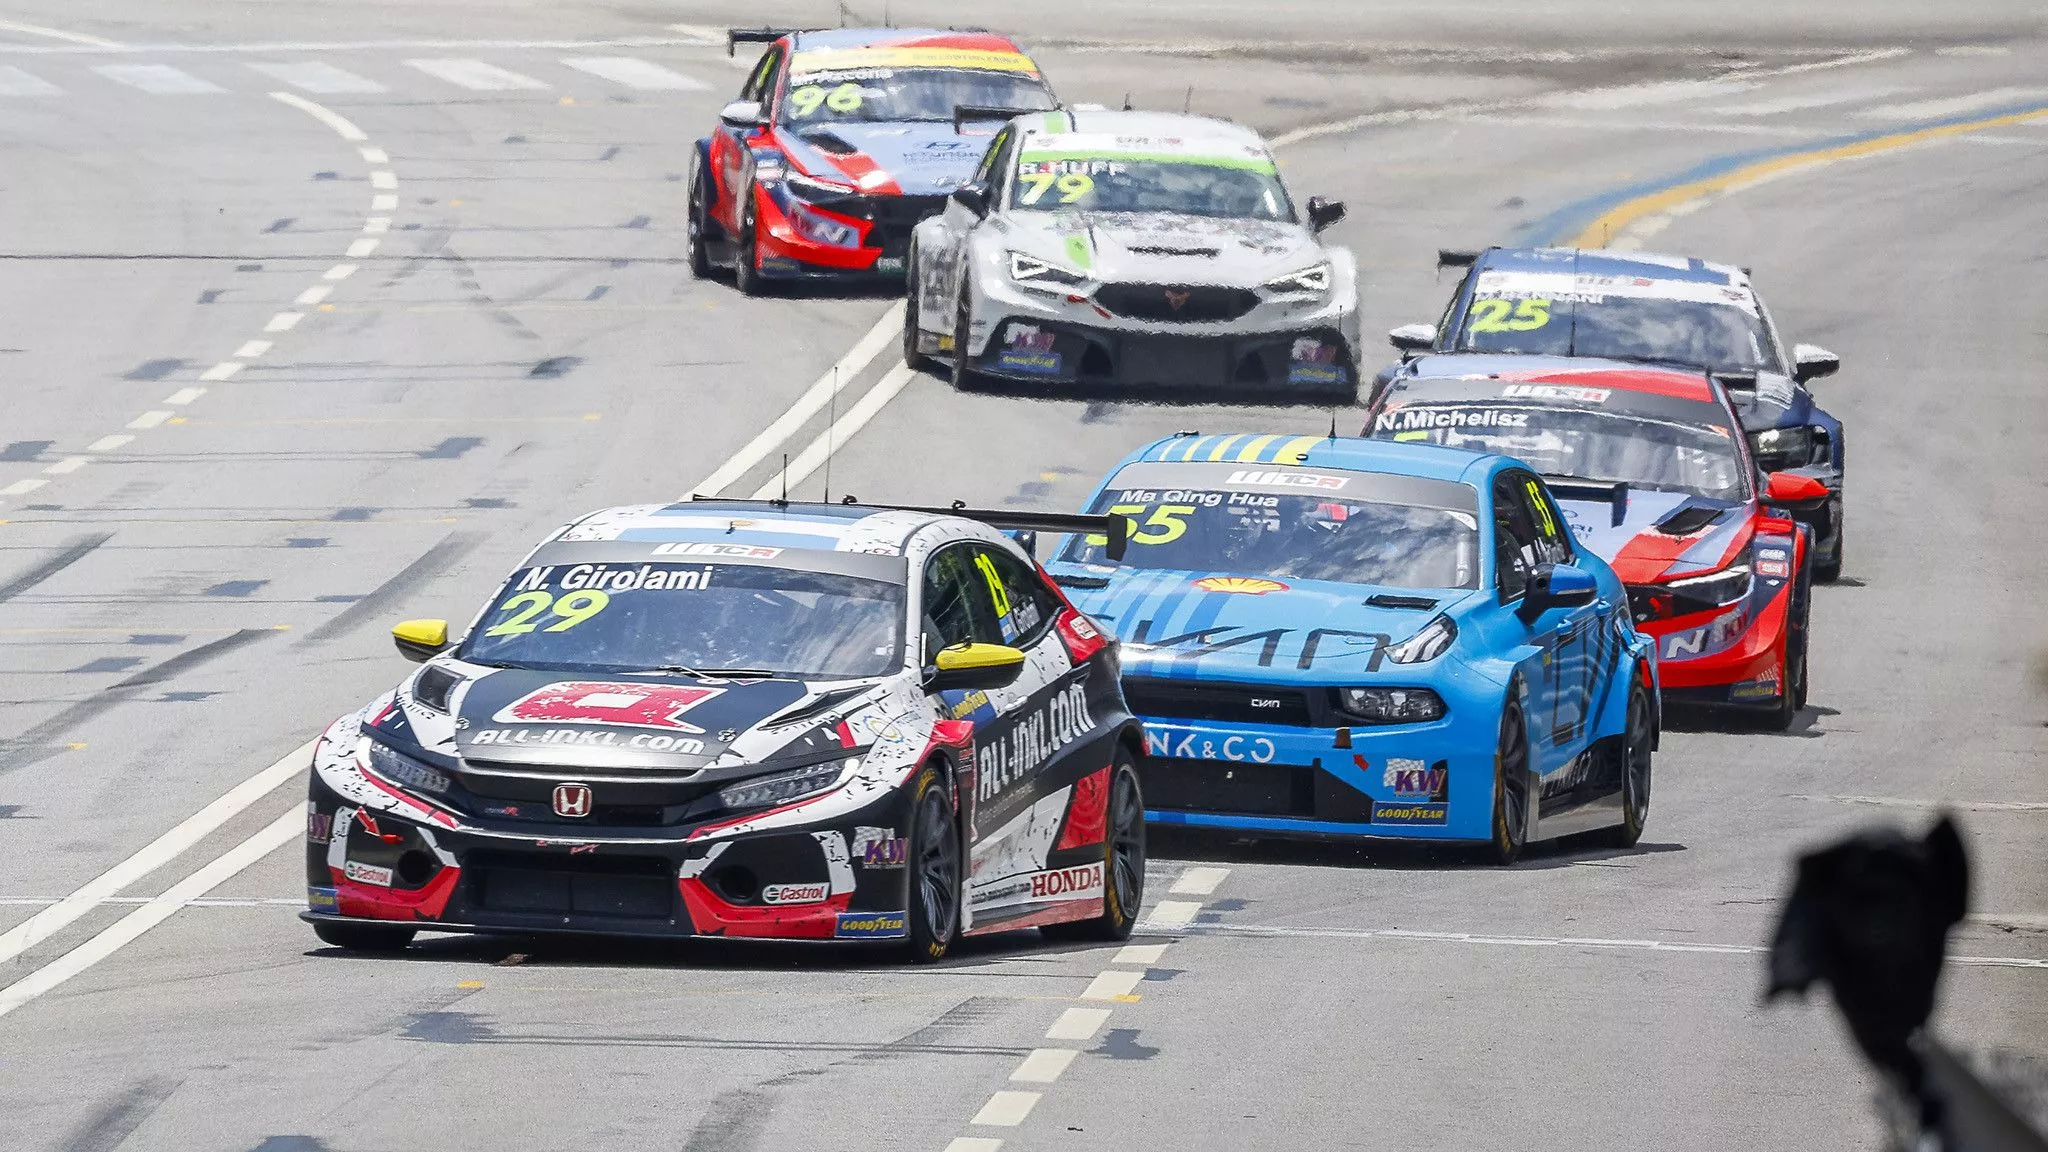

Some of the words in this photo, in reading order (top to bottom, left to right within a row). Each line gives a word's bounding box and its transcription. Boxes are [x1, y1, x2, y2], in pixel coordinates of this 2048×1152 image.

[789, 83, 863, 120] 96
[1018, 173, 1095, 205] 79
[1468, 299, 1550, 332] 25
[1375, 409, 1529, 431] N.Michelisz
[1119, 490, 1157, 503] Ma
[1163, 490, 1222, 507] Qing
[1227, 492, 1280, 507] Hua
[515, 566, 549, 592] N.
[560, 564, 714, 591] Girolami
[485, 589, 610, 637] 29
[1395, 769, 1446, 792] KW
[1376, 806, 1444, 820] GOODYEAR
[780, 886, 825, 900] Castrol
[1031, 866, 1102, 897] HONDA
